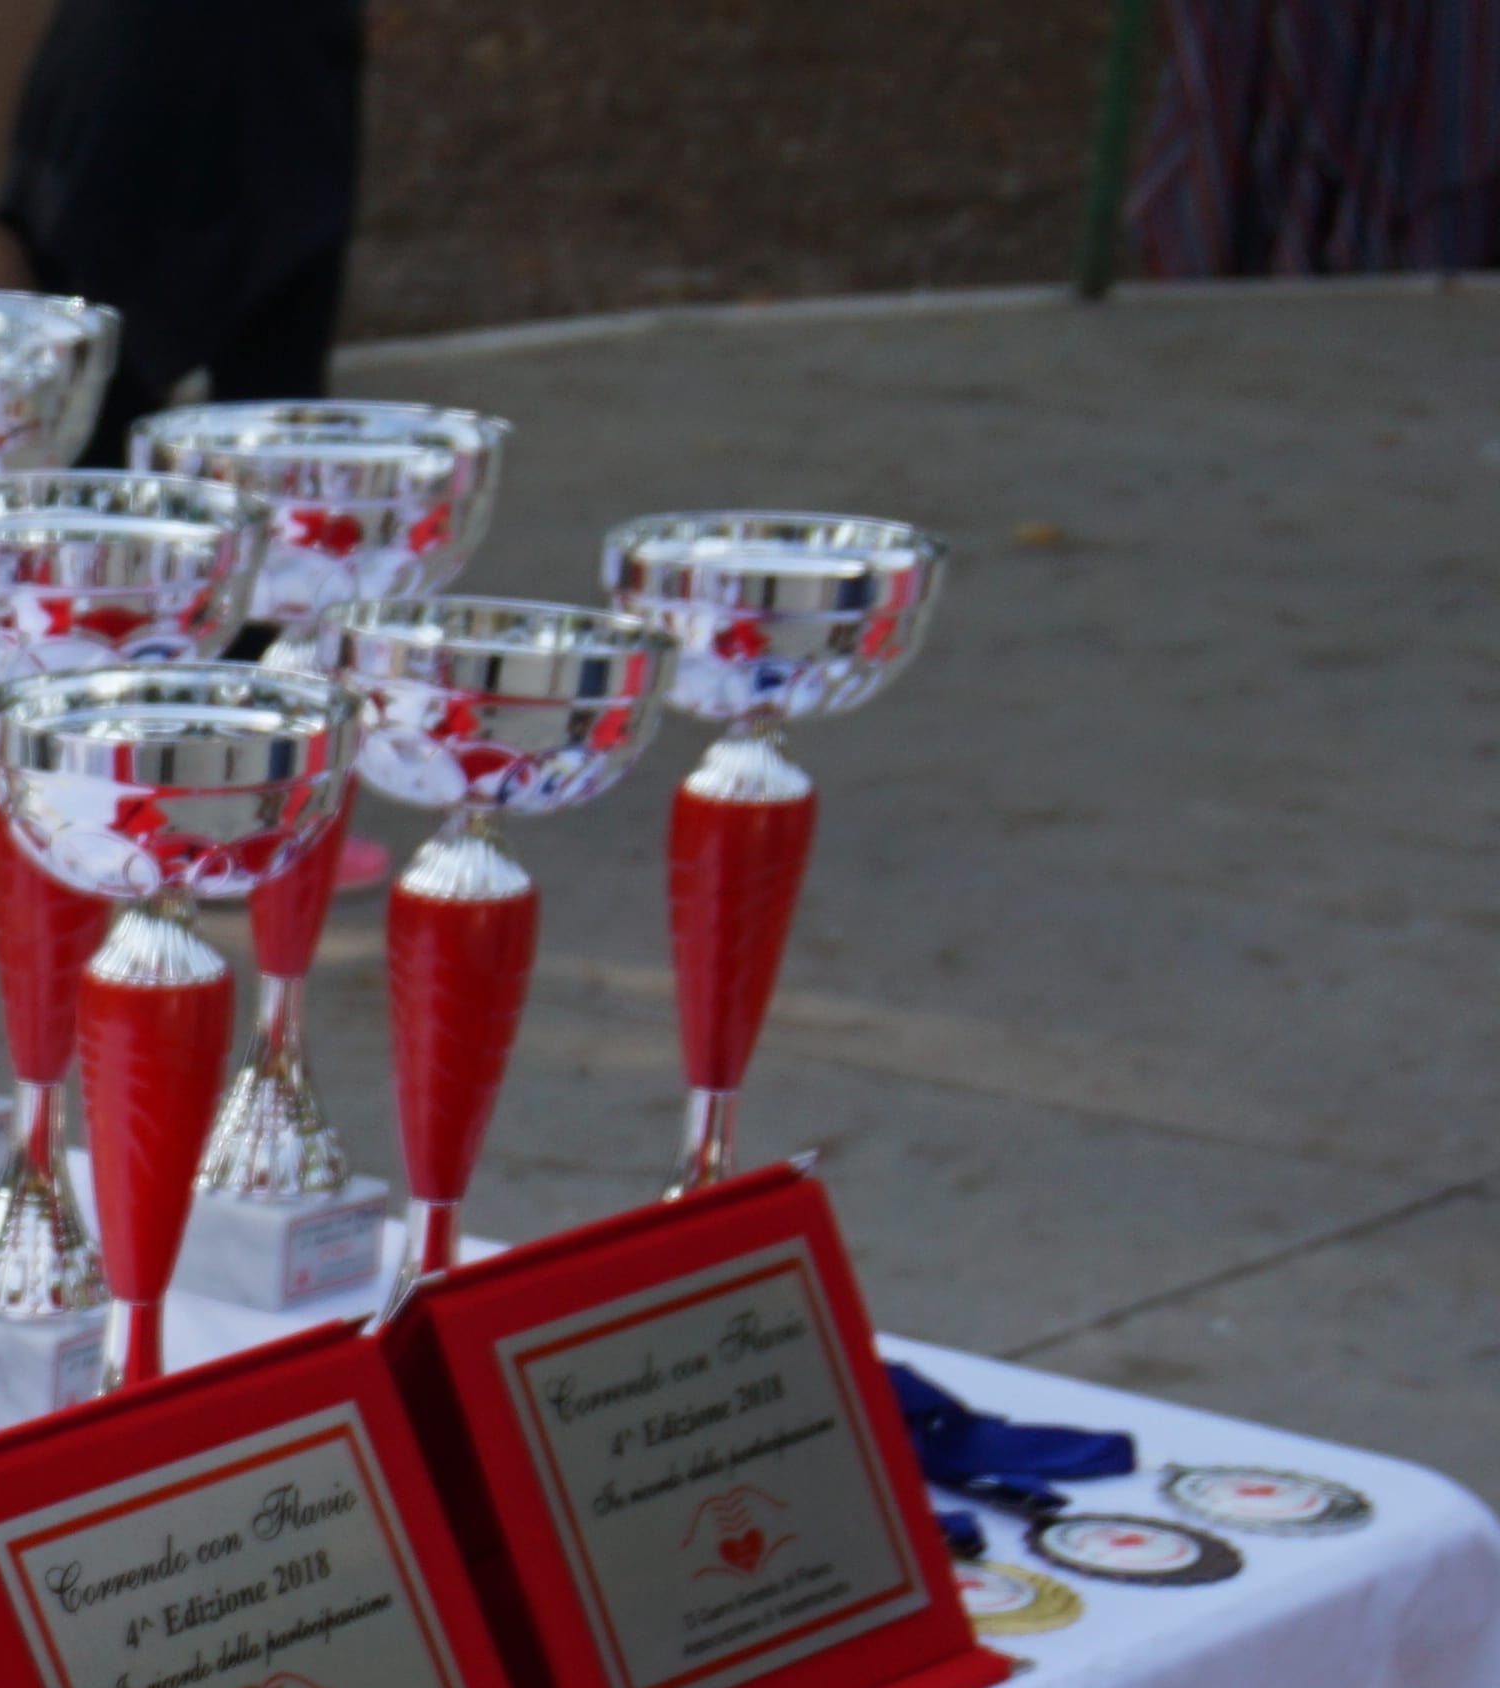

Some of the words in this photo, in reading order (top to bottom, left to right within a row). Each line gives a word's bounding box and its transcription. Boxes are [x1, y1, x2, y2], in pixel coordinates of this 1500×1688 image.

[44, 1533, 190, 1617] Correndo
[195, 1531, 243, 1565] con
[251, 1482, 357, 1541] Flavio
[125, 1615, 155, 1650] 4^
[160, 1580, 268, 1637] Edizione
[271, 1549, 330, 1595] 2018
